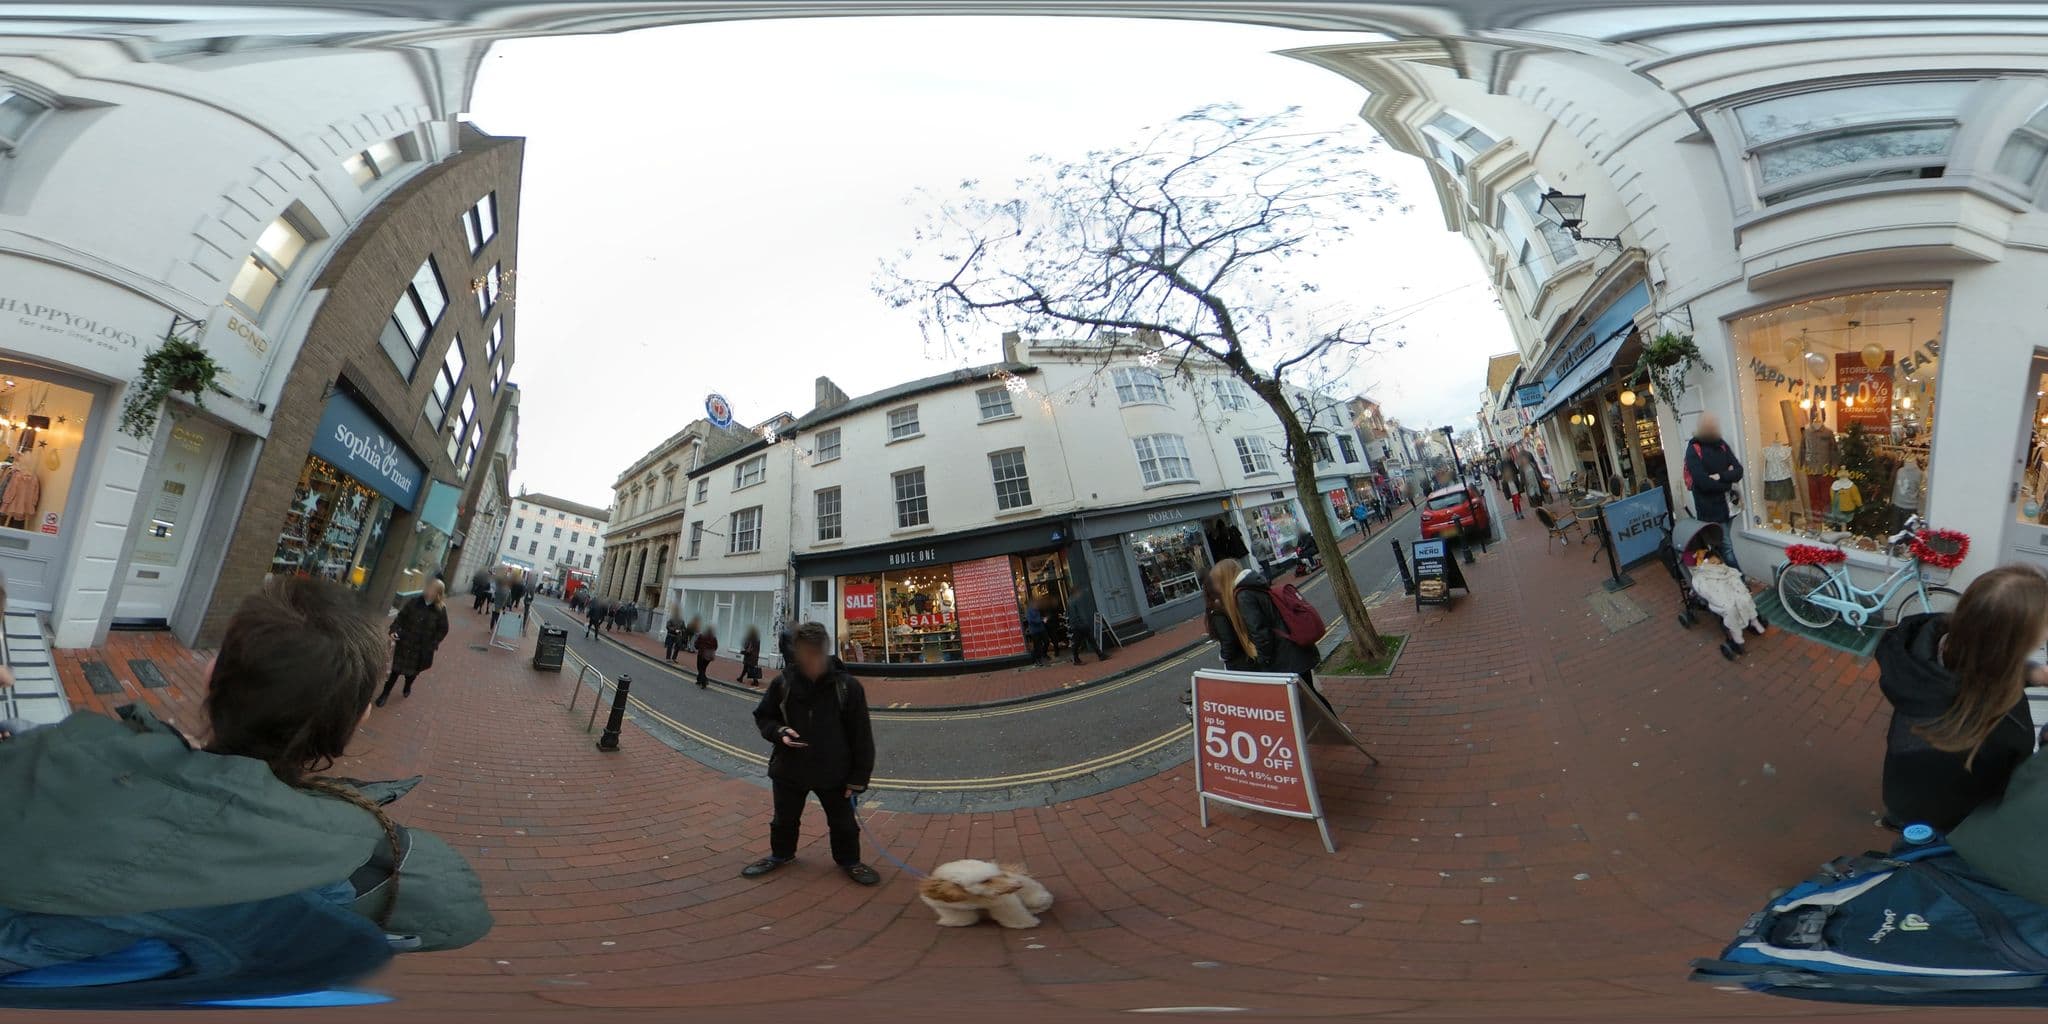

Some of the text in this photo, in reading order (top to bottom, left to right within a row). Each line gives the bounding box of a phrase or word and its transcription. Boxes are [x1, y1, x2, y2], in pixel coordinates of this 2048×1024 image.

[0, 298, 137, 348] HAPPYOLOGY
[227, 315, 268, 352] BOND
[334, 423, 381, 470] sophia
[390, 468, 412, 493] matt
[1147, 508, 1183, 523] PORTA
[1617, 513, 1664, 542] NERO
[889, 548, 936, 565] ROUTE ONE
[846, 594, 874, 609] SALE
[910, 613, 951, 626] SALE
[1203, 700, 1287, 722] STOREWIDE
[1204, 716, 1225, 726] up to
[1205, 725, 1292, 764] 50%
[1214, 762, 1247, 777] EXTRA
[1273, 775, 1298, 785] OFF
[1263, 757, 1294, 771] OFF
[1868, 908, 1896, 944] deuter
